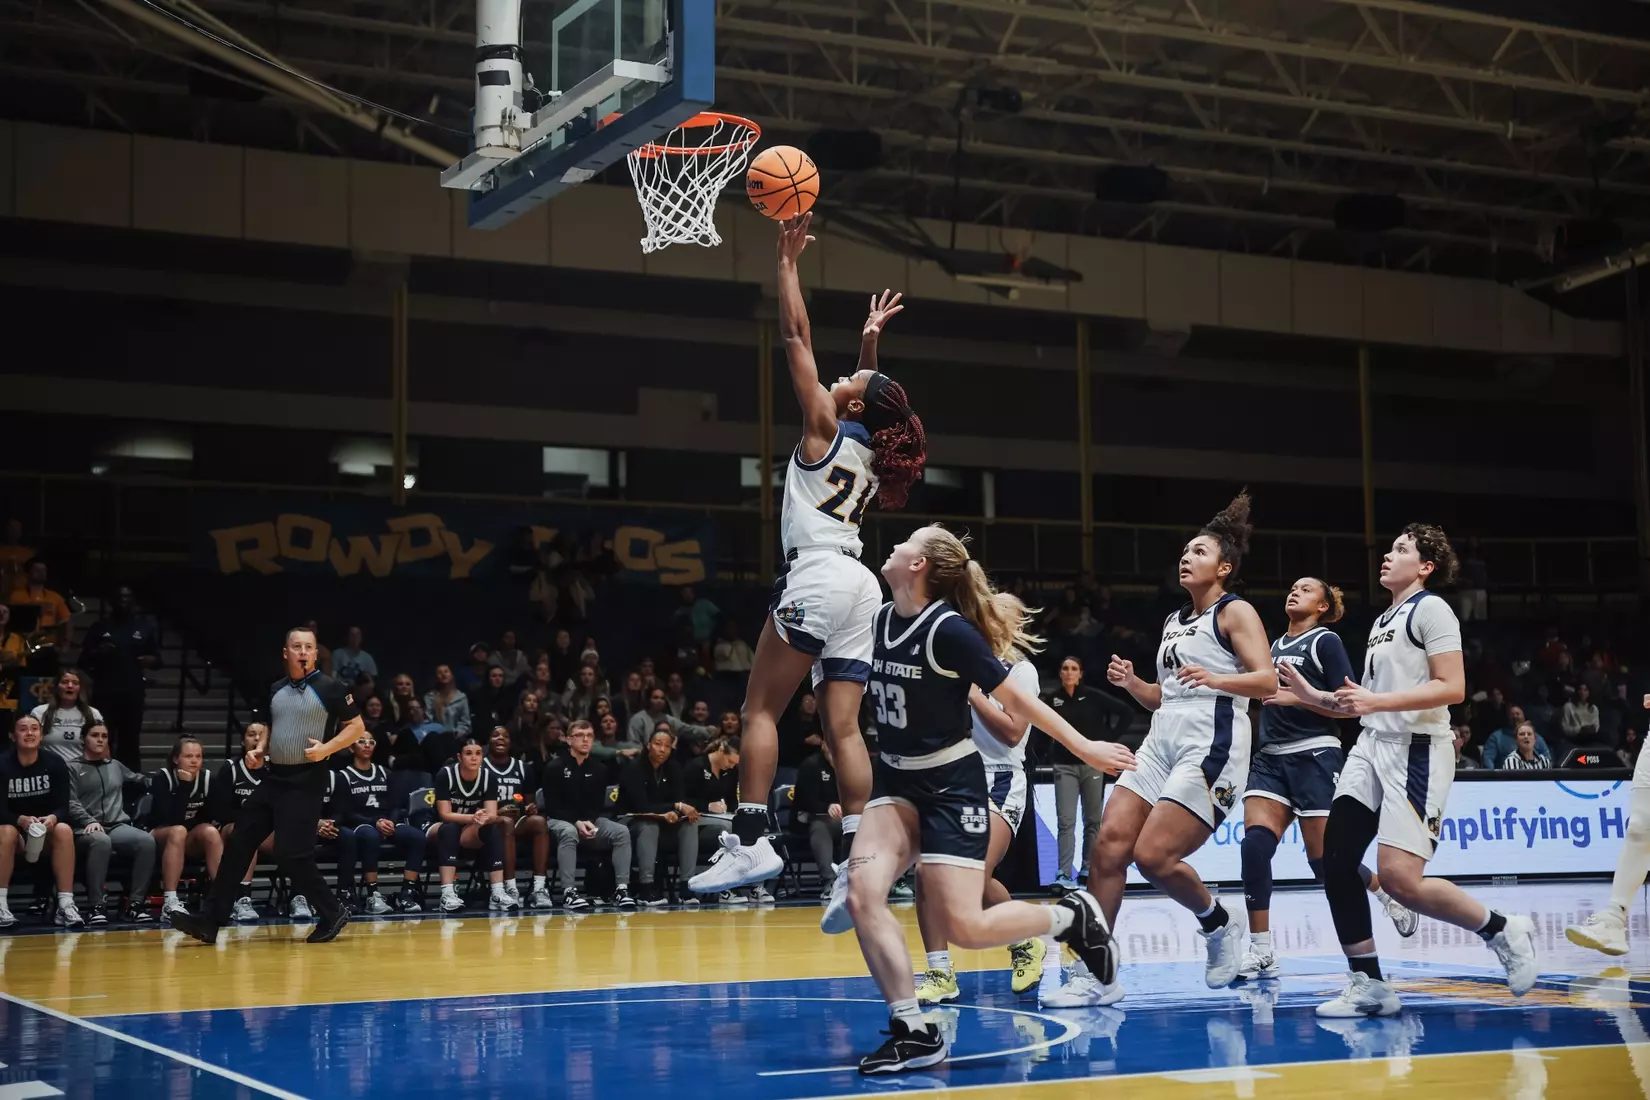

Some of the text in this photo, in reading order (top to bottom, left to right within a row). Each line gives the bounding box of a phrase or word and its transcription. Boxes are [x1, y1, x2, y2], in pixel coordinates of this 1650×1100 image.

[208, 512, 496, 580] ROWDY
[1163, 643, 1182, 670] 41
[884, 661, 923, 680] STATE
[869, 679, 908, 730] 33
[8, 774, 51, 793] AGGIES
[350, 785, 370, 795] UTAH
[365, 793, 380, 808] 4
[960, 814, 989, 825] STATE
[1598, 806, 1632, 842] H
